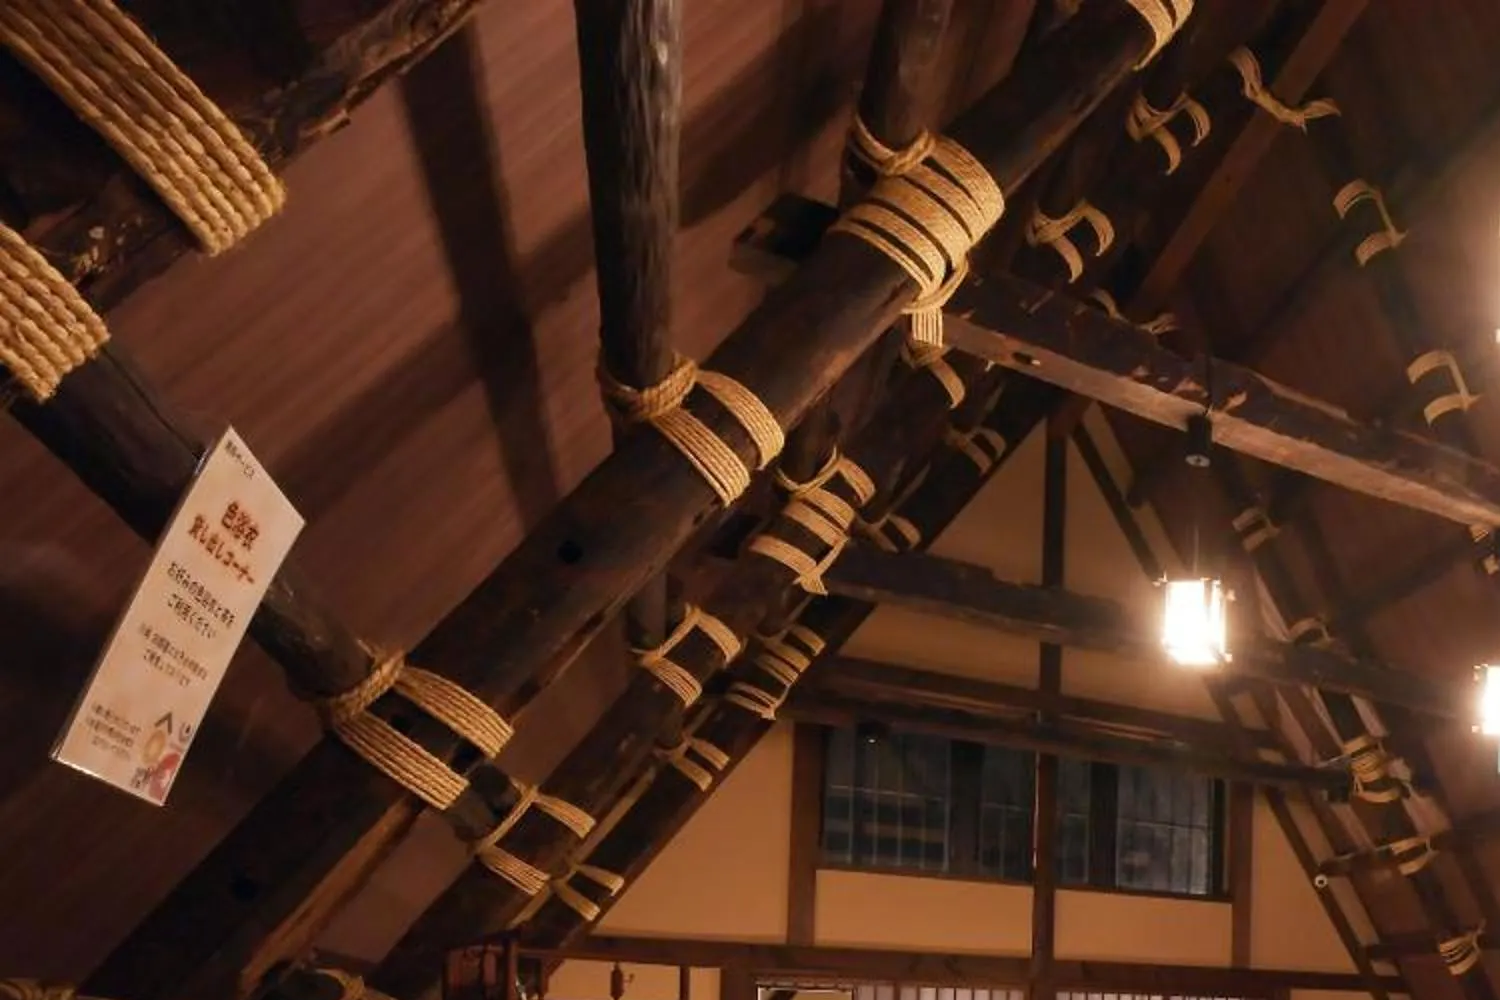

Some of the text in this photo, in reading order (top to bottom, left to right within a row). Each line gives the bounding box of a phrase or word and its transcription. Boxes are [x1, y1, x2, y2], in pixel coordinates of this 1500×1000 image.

[187, 512, 257, 586] 貸し出しコーナー
[220, 498, 261, 551] 色浴衣
